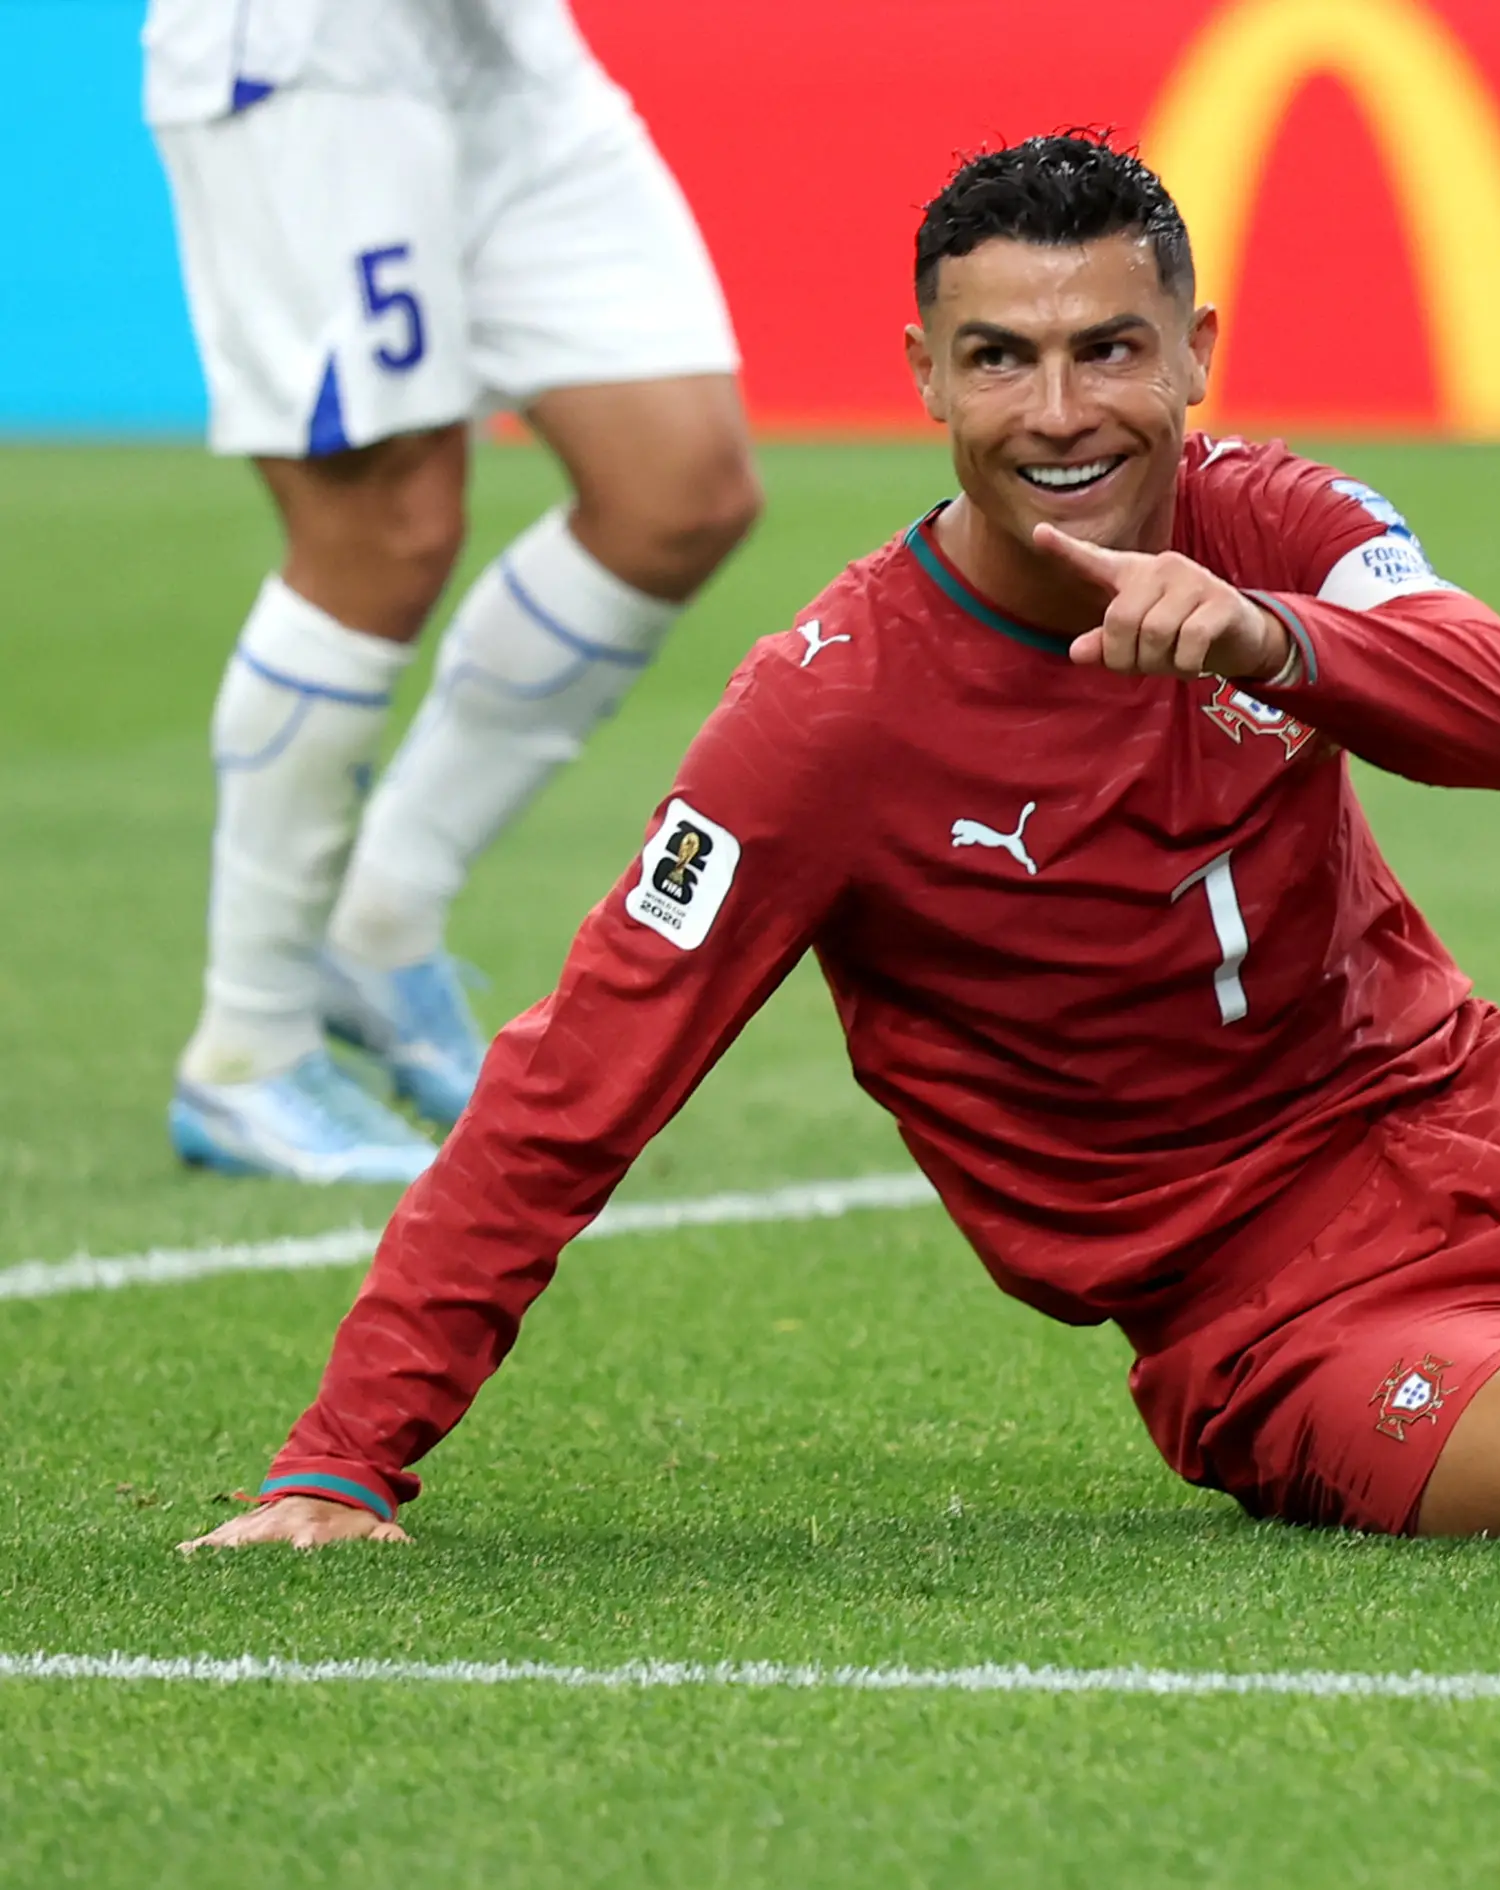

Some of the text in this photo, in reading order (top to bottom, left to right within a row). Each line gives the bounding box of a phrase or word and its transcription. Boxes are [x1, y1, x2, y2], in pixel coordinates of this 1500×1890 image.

[355, 240, 428, 375] 5
[640, 900, 682, 930] 2026
[661, 879, 683, 898] FIFA
[1170, 847, 1249, 1027] 7
